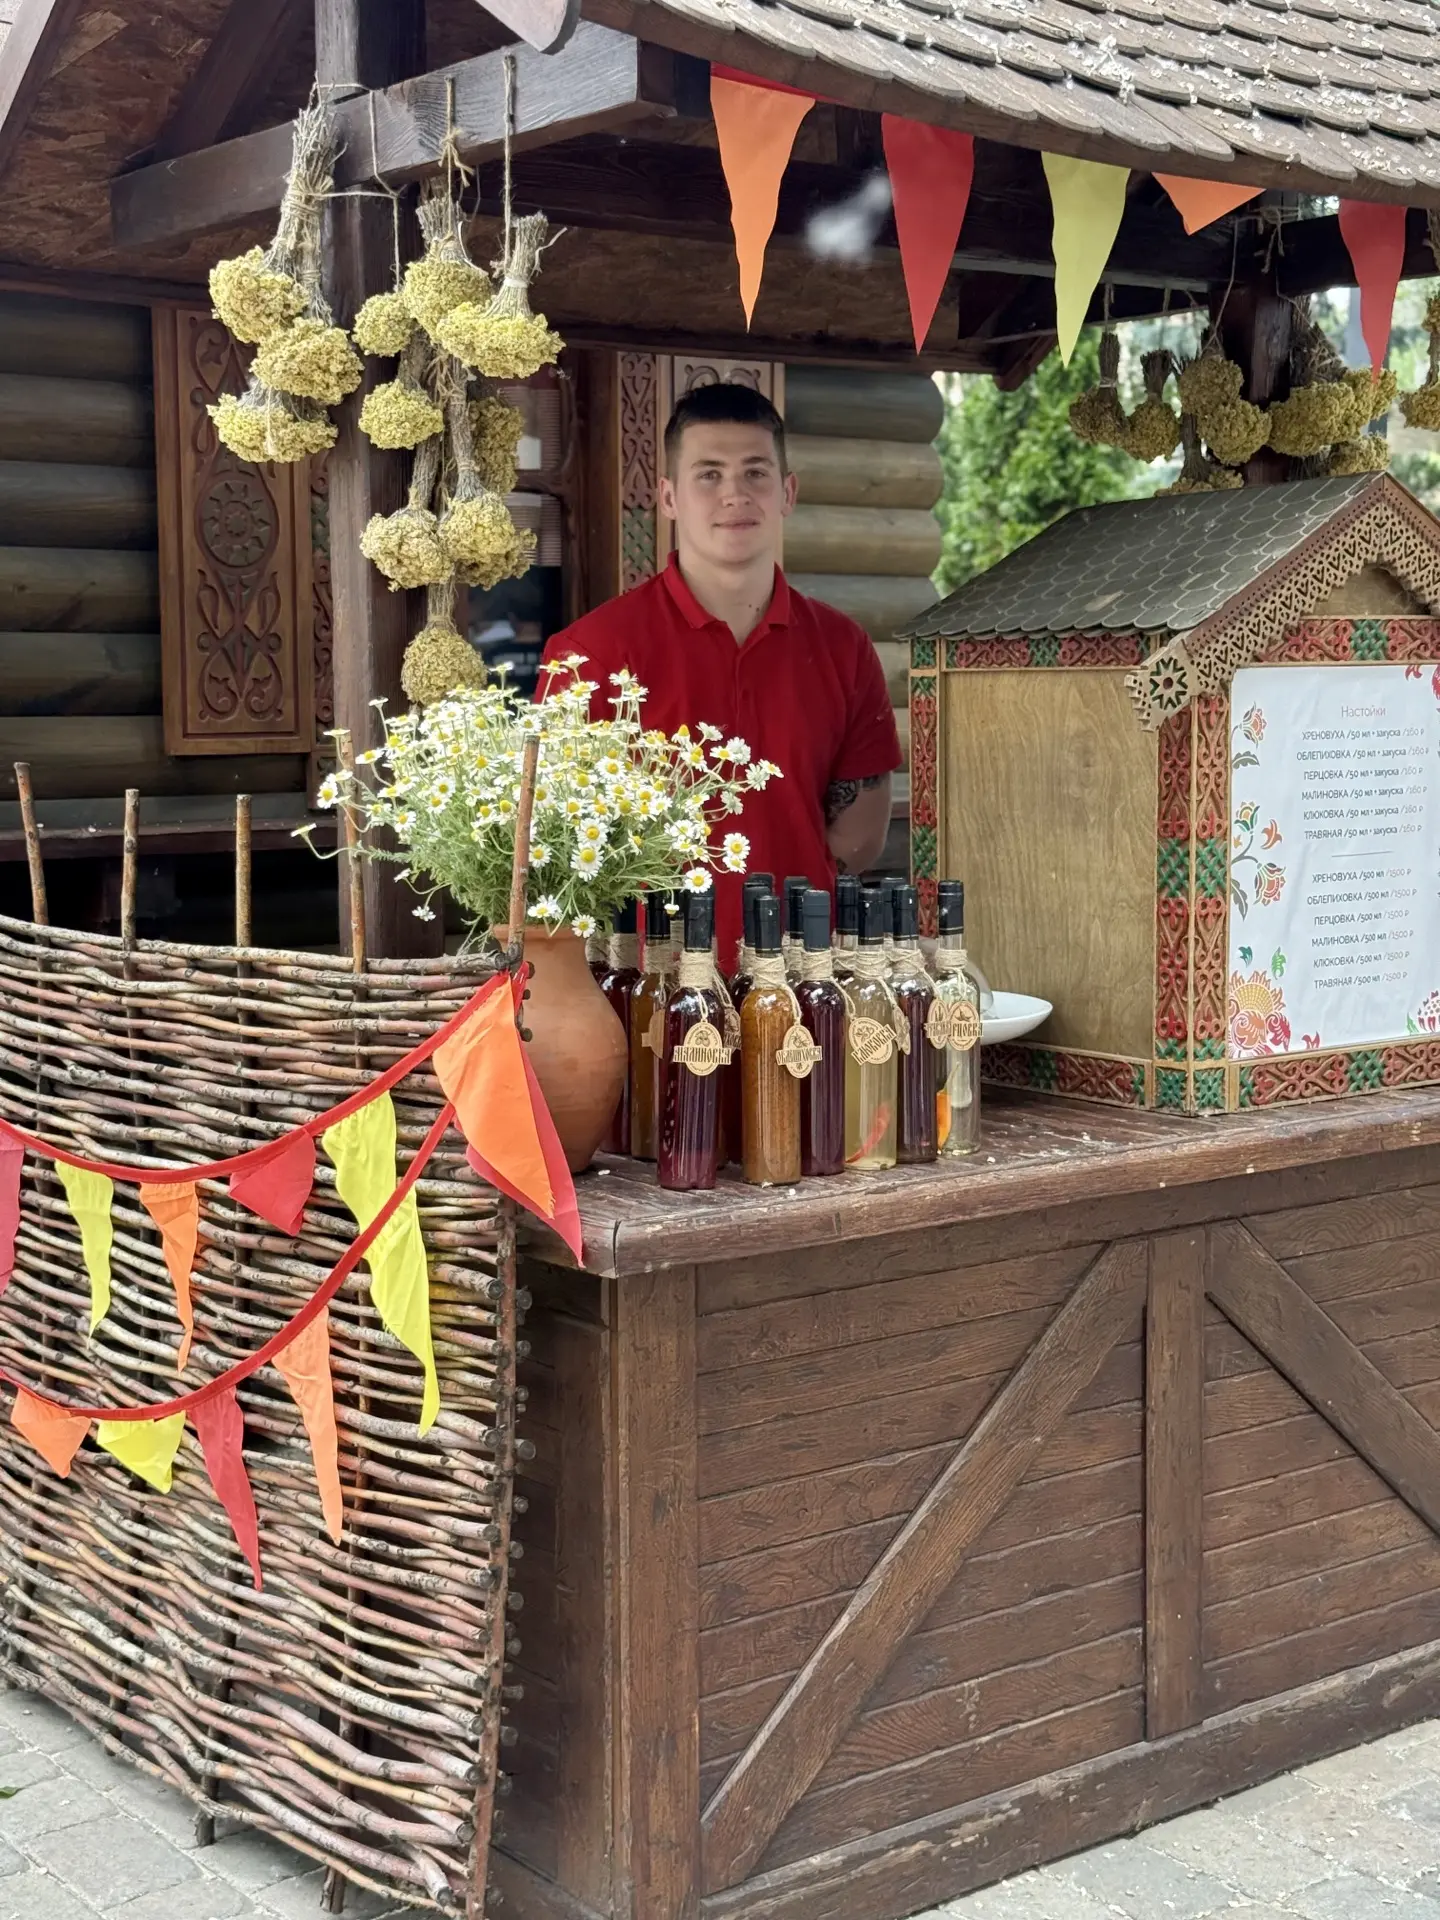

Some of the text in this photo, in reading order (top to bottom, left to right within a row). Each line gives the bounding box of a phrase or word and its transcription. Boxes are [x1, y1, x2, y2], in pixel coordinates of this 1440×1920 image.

[1341, 705, 1386, 718] Настойки
[1302, 730, 1345, 740] ХРЕНОВУХА
[1376, 729, 1400, 739] закуска
[1297, 750, 1351, 761] ОБЛЕПИХОВКА
[1382, 749, 1406, 758] закуска
[1304, 770, 1343, 780] ПЕРЦОВКА
[1374, 768, 1399, 778] закуска
[1302, 790, 1348, 800] МАЛИНОВКА
[1378, 788, 1403, 797] закуска
[1304, 809, 1344, 820] КЛЮКОВКА
[1375, 807, 1398, 817] закуска
[1305, 829, 1342, 839] ТРАВЯНАЯ
[1373, 826, 1397, 836] закуска
[1312, 872, 1357, 883] ХРЕНОВУХА
[1307, 892, 1362, 905] ОБЛЕПИХОВКА
[1314, 914, 1355, 926] ПЕРЦОВКА
[1312, 934, 1359, 947] МАЛИНОВКА
[1314, 956, 1354, 968] КЛЮКОВКА
[1315, 977, 1352, 989] ТРАВЯНАЯ
